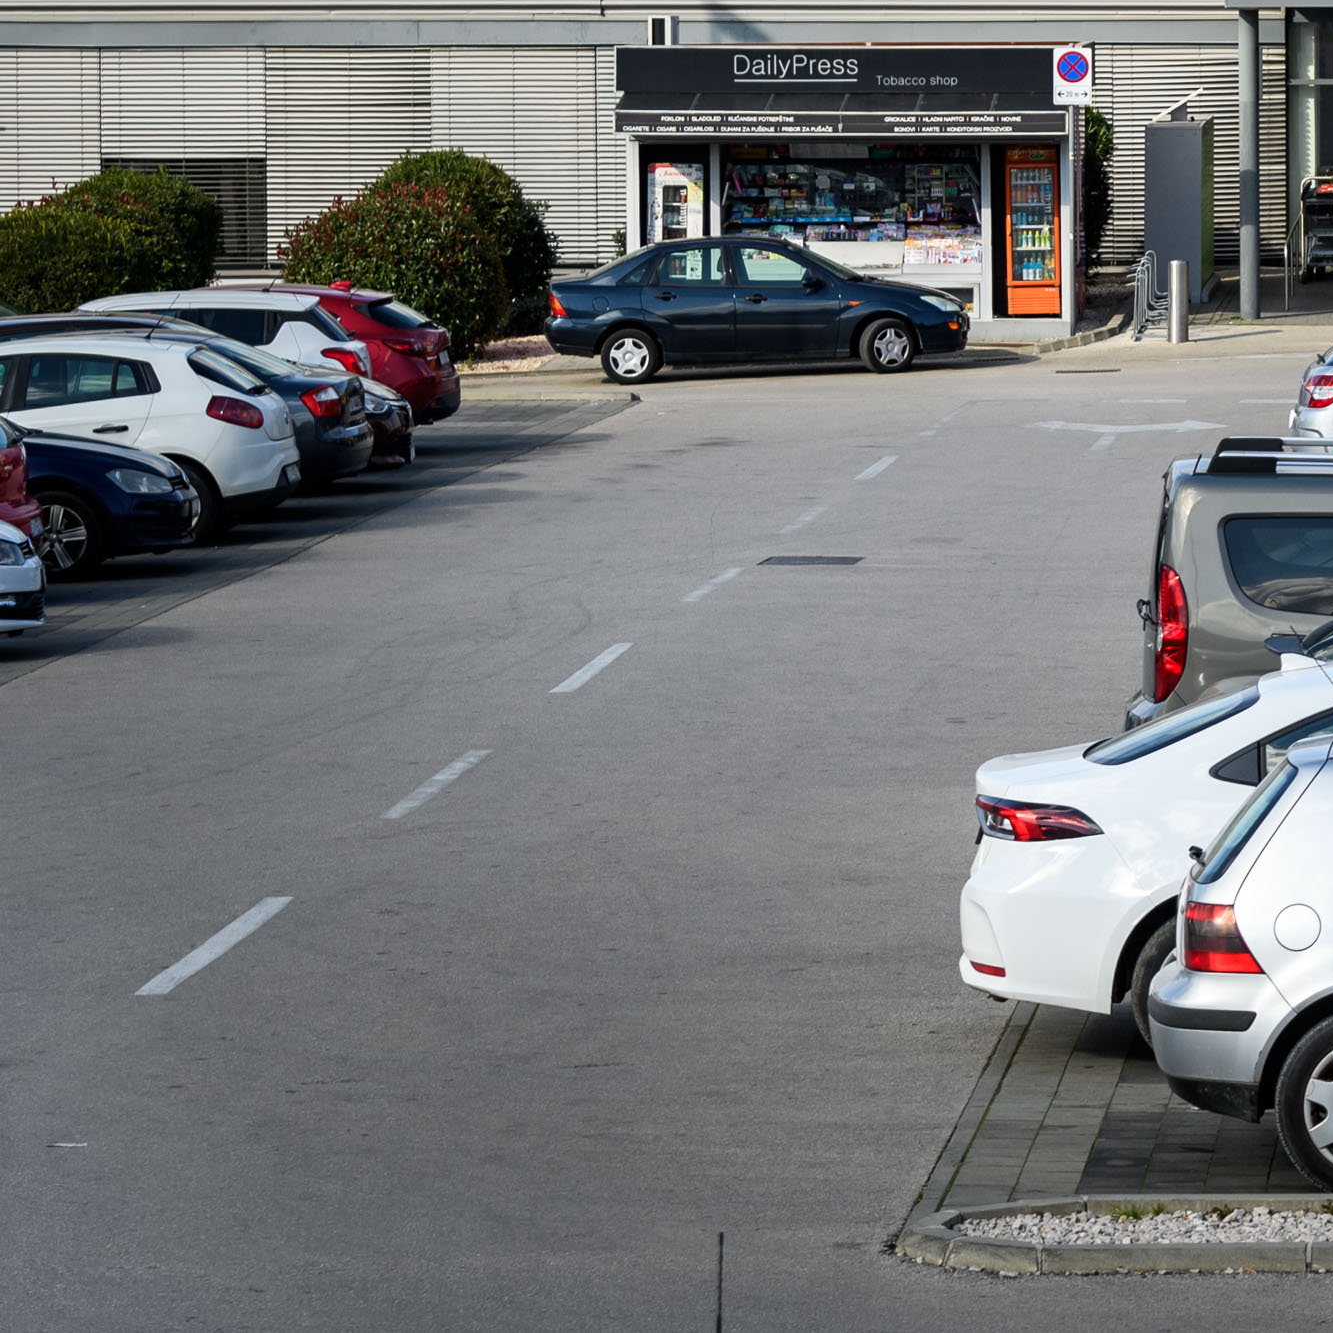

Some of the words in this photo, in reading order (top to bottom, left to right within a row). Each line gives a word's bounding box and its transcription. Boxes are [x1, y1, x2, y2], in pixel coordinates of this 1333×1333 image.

[734, 54, 859, 79] DailyPress
[876, 75, 926, 86] Tobacco
[929, 75, 958, 87] shop
